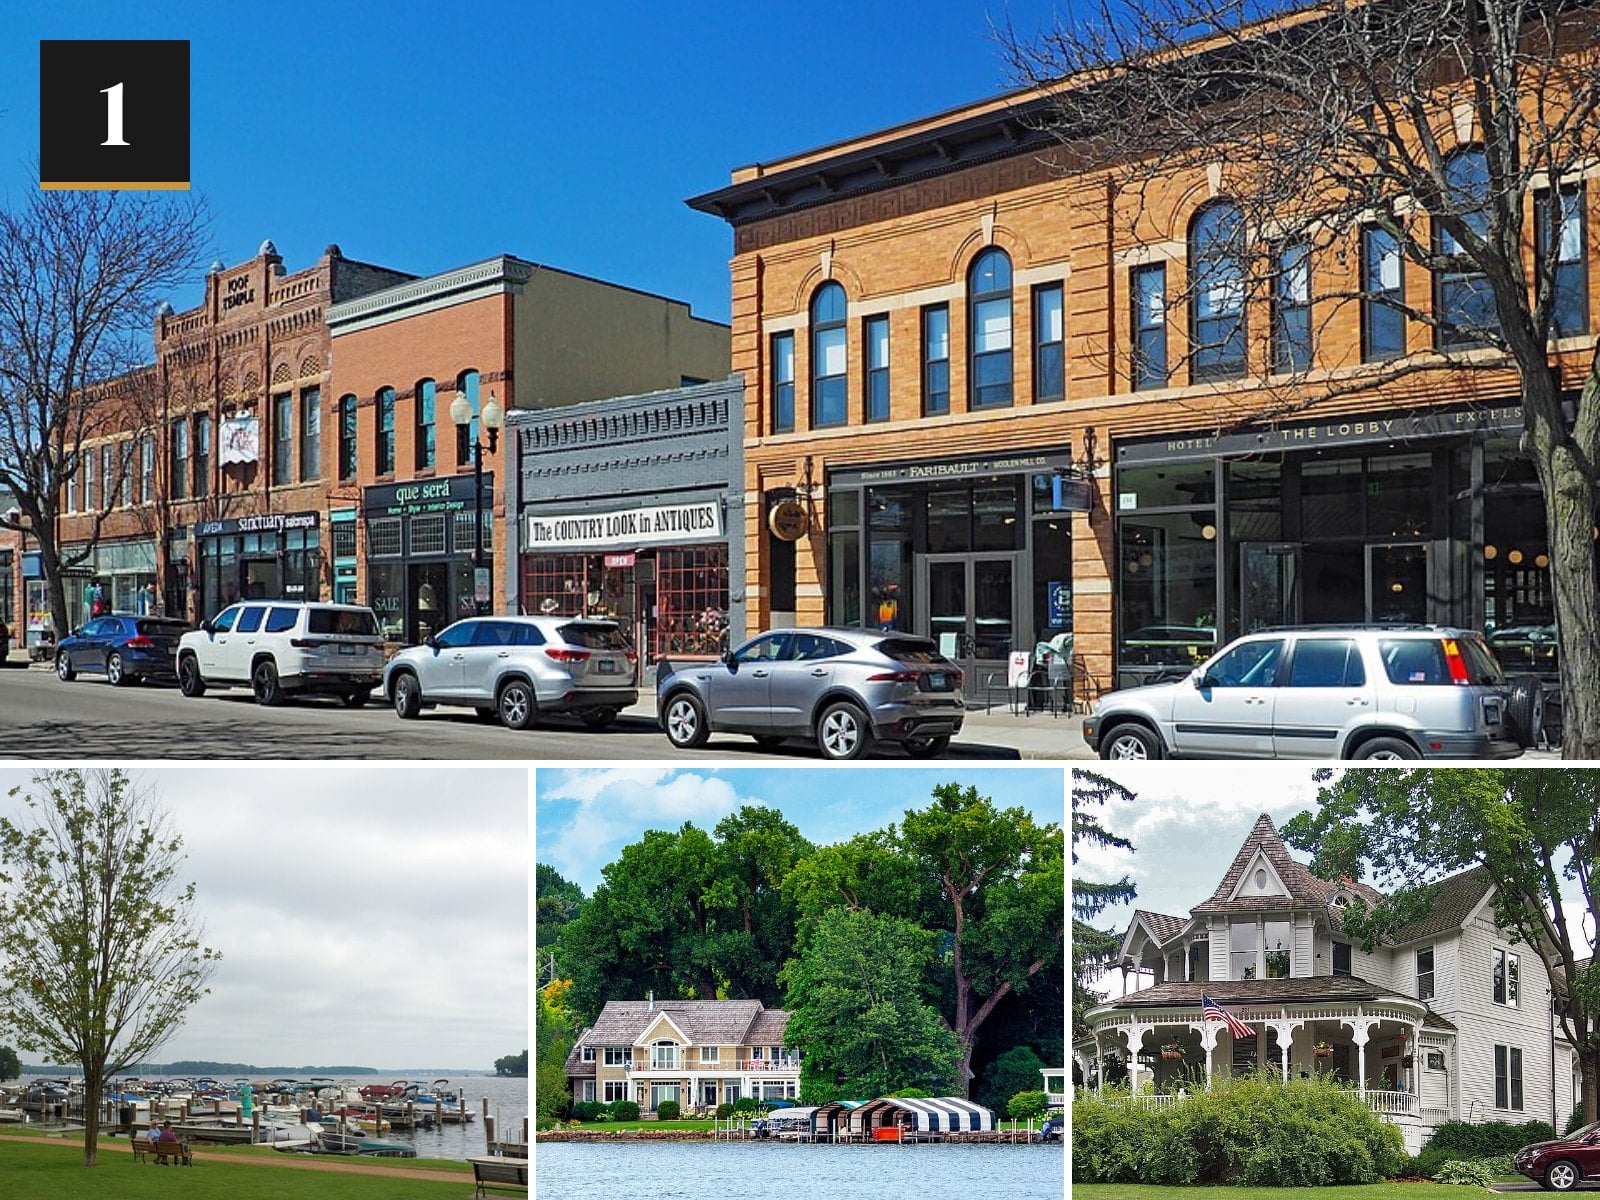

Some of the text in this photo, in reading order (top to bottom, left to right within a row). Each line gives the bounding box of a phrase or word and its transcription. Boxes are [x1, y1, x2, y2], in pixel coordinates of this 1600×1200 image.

[228, 274, 249, 294] IOOF
[223, 288, 254, 312] TEMPLE
[1167, 438, 1212, 451] HOTEL
[1281, 426, 1317, 440] THE
[1327, 420, 1393, 437] LOBBY
[910, 463, 979, 477] FARIBAULT
[396, 478, 450, 505] que será
[238, 515, 285, 533] sanctuary
[533, 507, 714, 541] The COUNTRY LOOK in ANTIQUES
[374, 597, 399, 611] SALE
